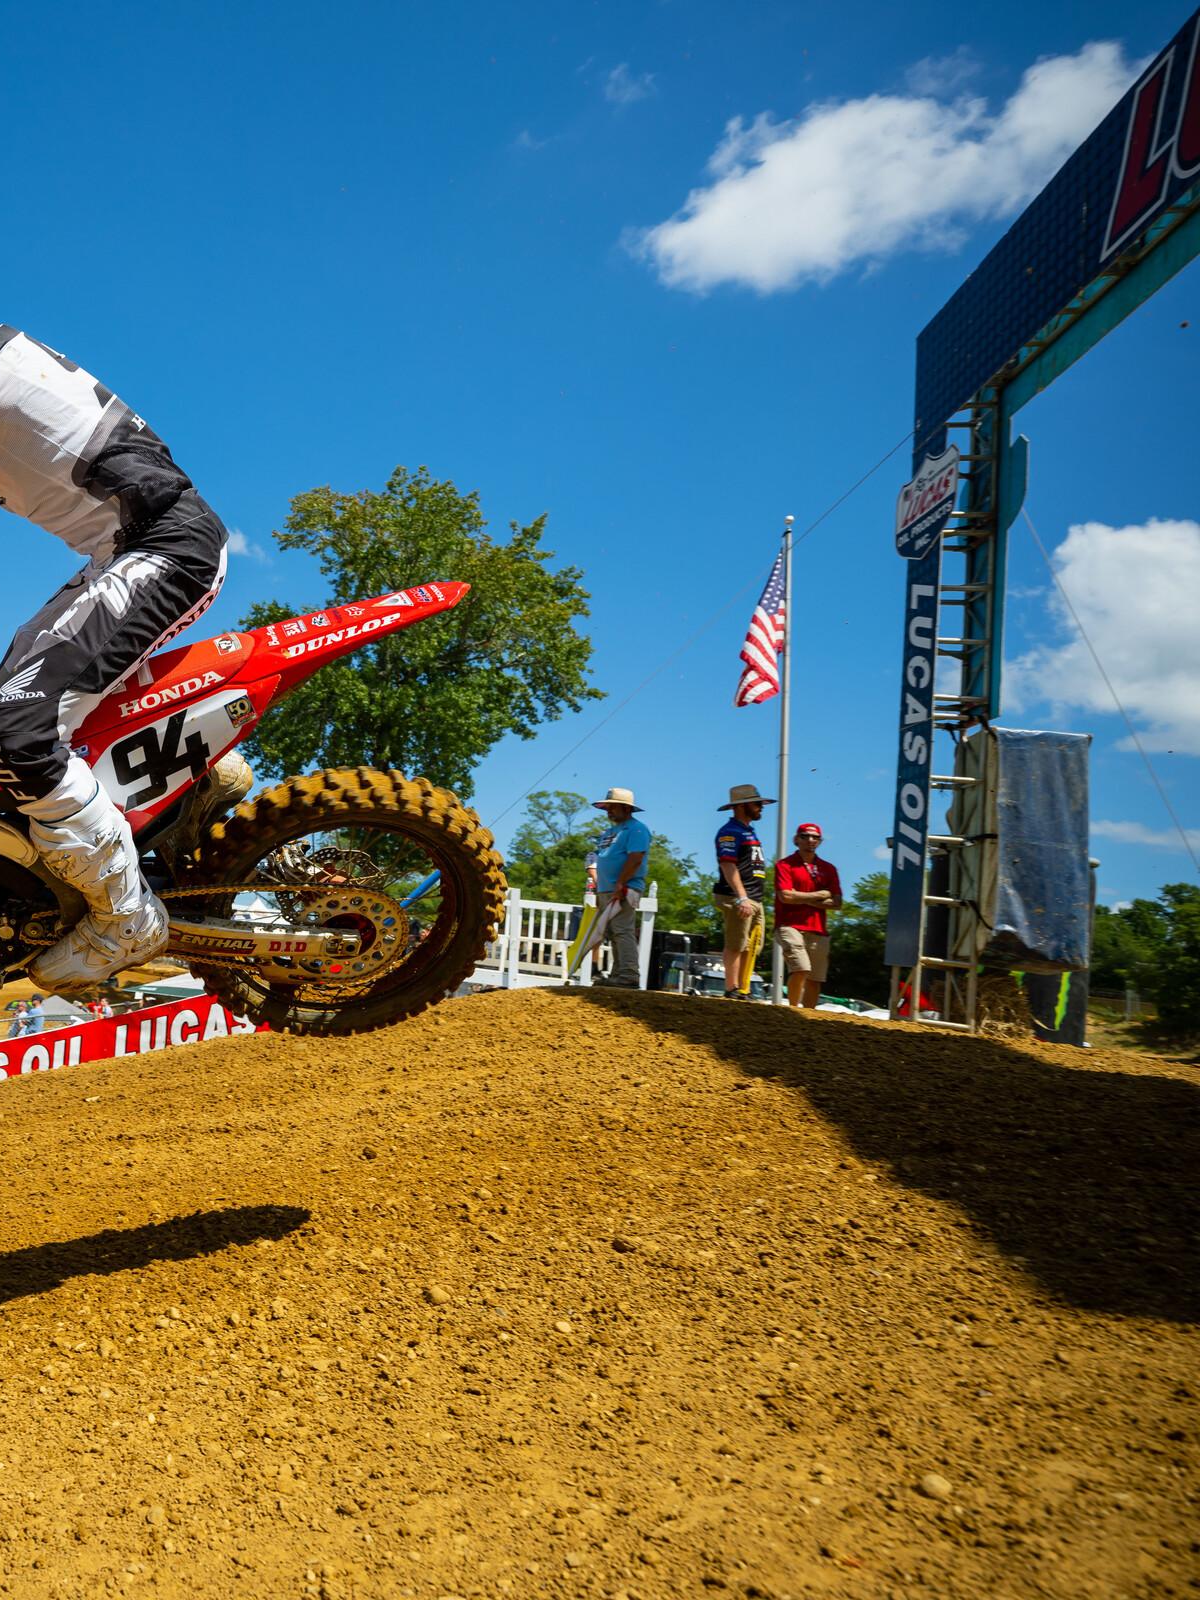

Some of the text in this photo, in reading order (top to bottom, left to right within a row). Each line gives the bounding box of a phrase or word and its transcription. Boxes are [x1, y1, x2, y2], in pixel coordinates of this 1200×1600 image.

[902, 467, 955, 528] LUCAS
[910, 500, 953, 538] PRODUCTS
[287, 613, 401, 658] DUNLOP
[118, 671, 225, 717] HONDA
[897, 584, 935, 870] LUCAS OIL
[111, 708, 210, 812] 94
[180, 934, 254, 950] ENTHAL
[21, 1036, 82, 1075] OIL
